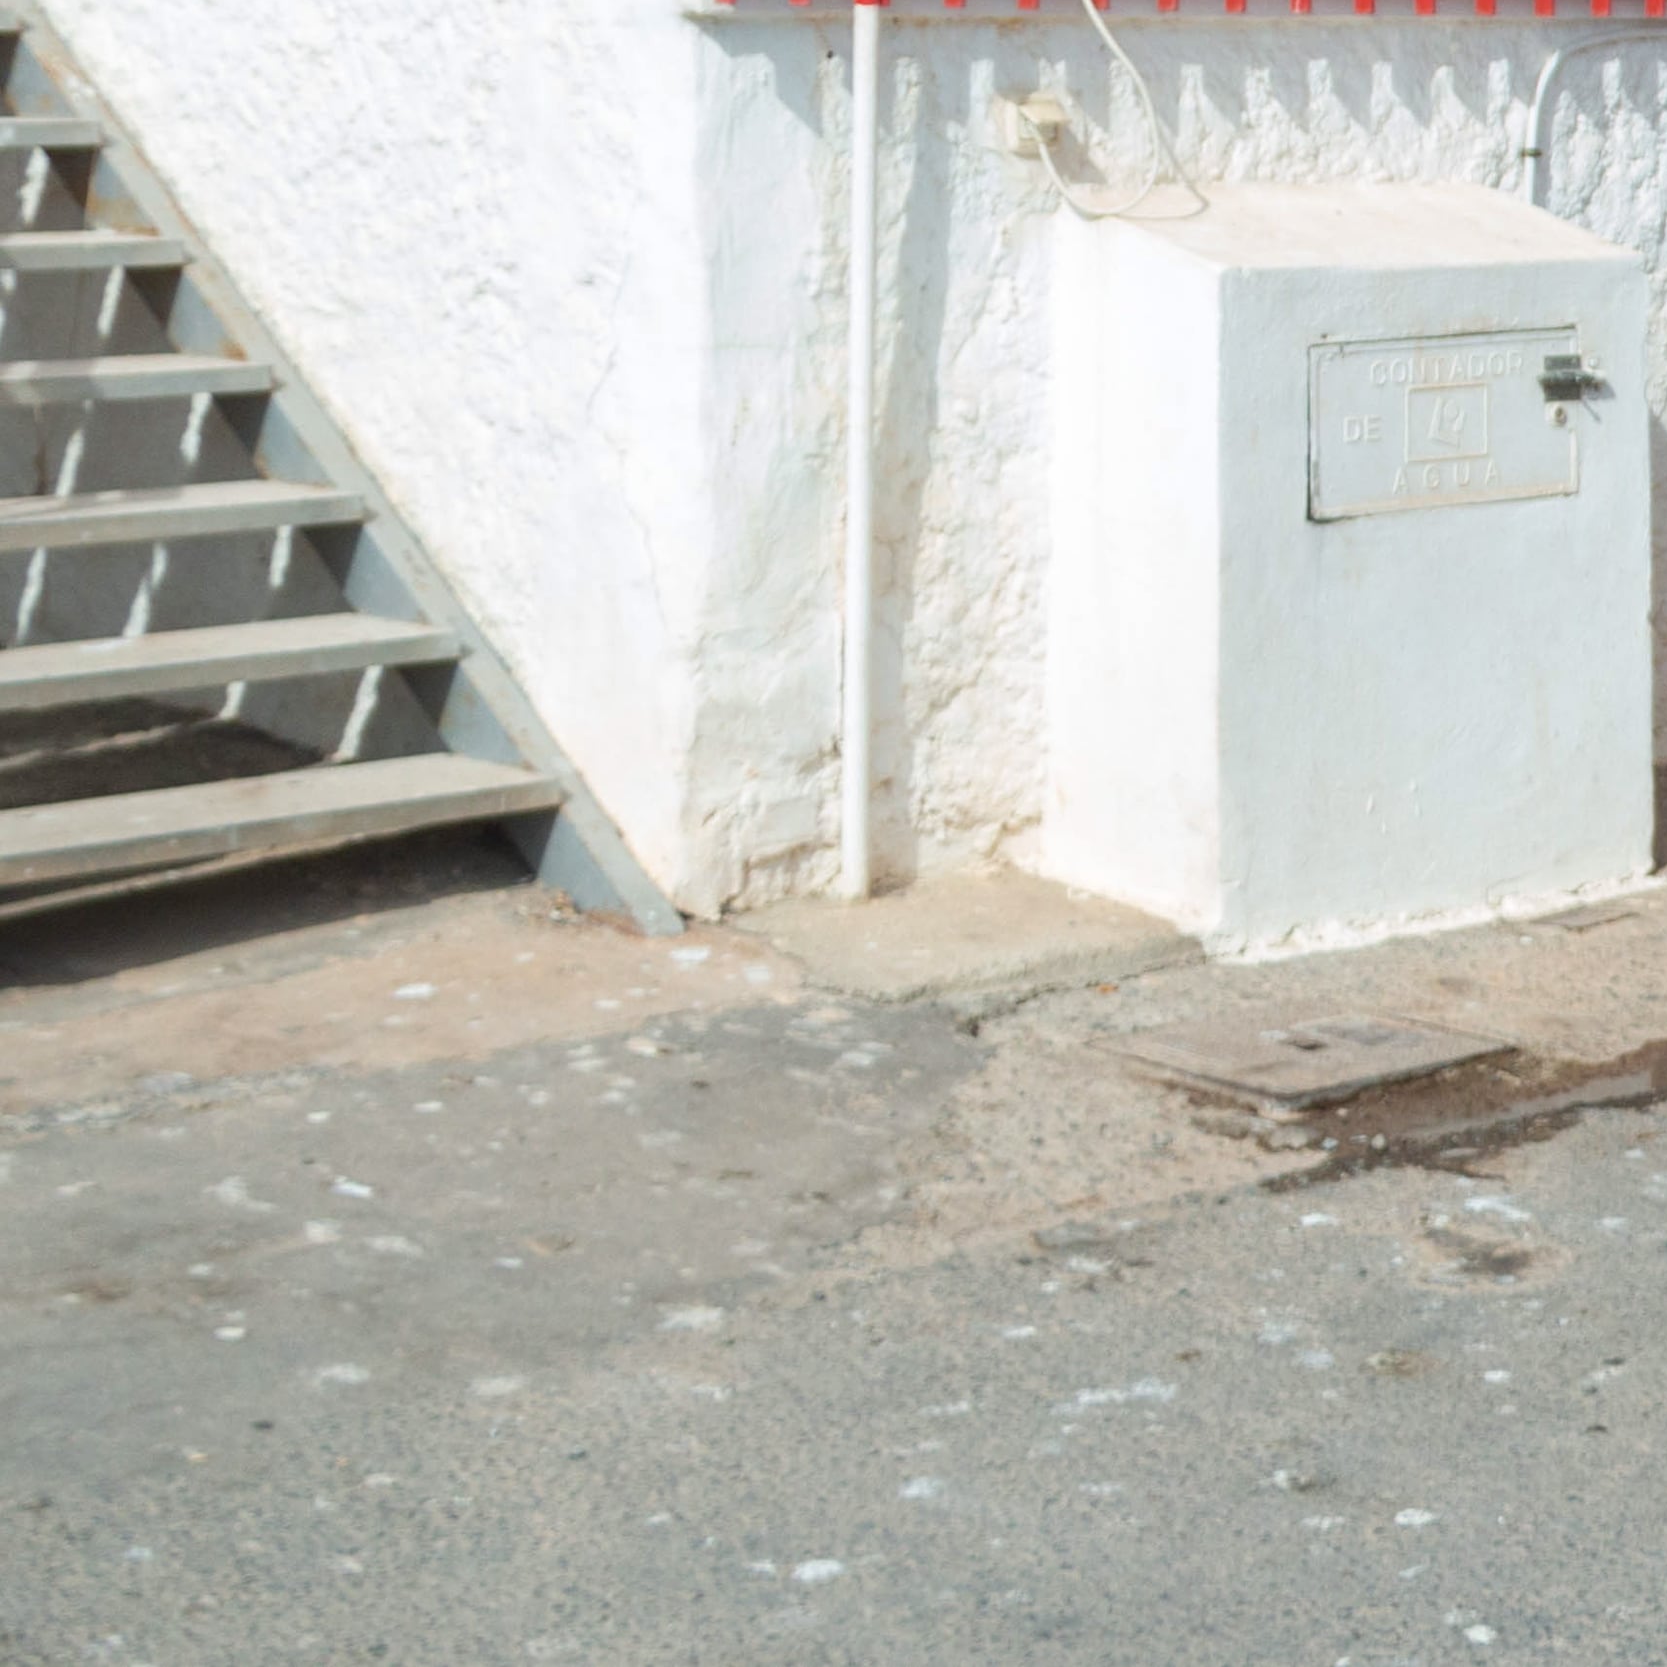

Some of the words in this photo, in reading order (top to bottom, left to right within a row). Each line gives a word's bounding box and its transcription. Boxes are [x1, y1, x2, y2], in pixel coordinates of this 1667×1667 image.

[1369, 349, 1524, 386] CONTADOR
[1342, 414, 1383, 444] DE
[1391, 458, 1503, 497] AGUA
